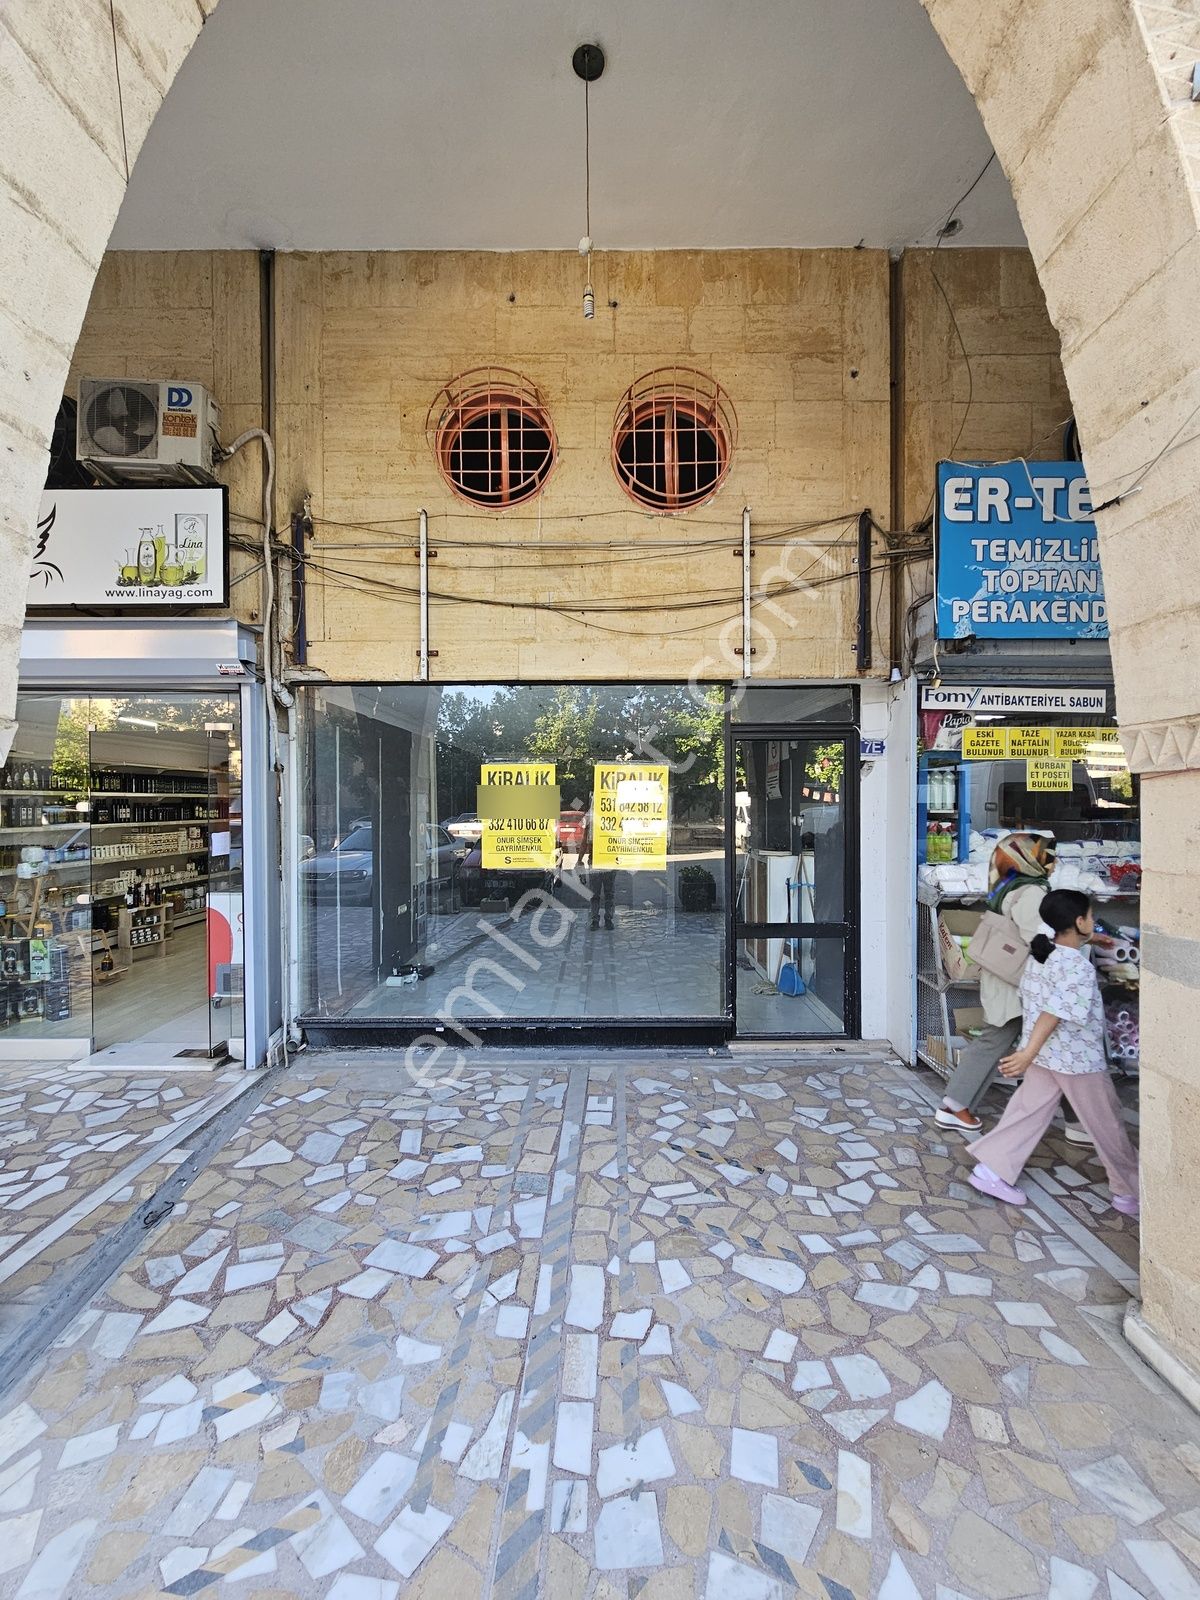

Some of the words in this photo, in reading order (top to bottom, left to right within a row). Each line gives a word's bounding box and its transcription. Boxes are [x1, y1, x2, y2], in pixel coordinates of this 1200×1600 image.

[179, 537, 203, 549] Lina
[982, 569, 1098, 593] TOPTAN
[105, 588, 213, 599] www.linayag.com
[952, 600, 1108, 623] PERAKEND
[980, 693, 1066, 707] ANTİBAKTERİYEL
[1069, 696, 1103, 708] SABUN
[942, 713, 971, 728] Papia
[976, 729, 994, 738] ESKİ
[1020, 729, 1041, 737] TAZE
[1056, 730, 1077, 738] YAZAR
[864, 741, 882, 753] 7E
[970, 739, 1000, 747] GAZETE
[1011, 738, 1050, 747] NAFTALİN
[966, 748, 1004, 756] BULUNUR
[1011, 748, 1049, 756] BULUNUR
[1034, 762, 1066, 770] KURBAN
[1030, 771, 1039, 779] ET
[1032, 780, 1069, 788] BULUNUR
[600, 798, 616, 812] 531
[489, 818, 505, 831] 332
[600, 816, 617, 831] 332
[496, 836, 515, 844] ONUR
[495, 844, 543, 852] GAYRİMENKUL
